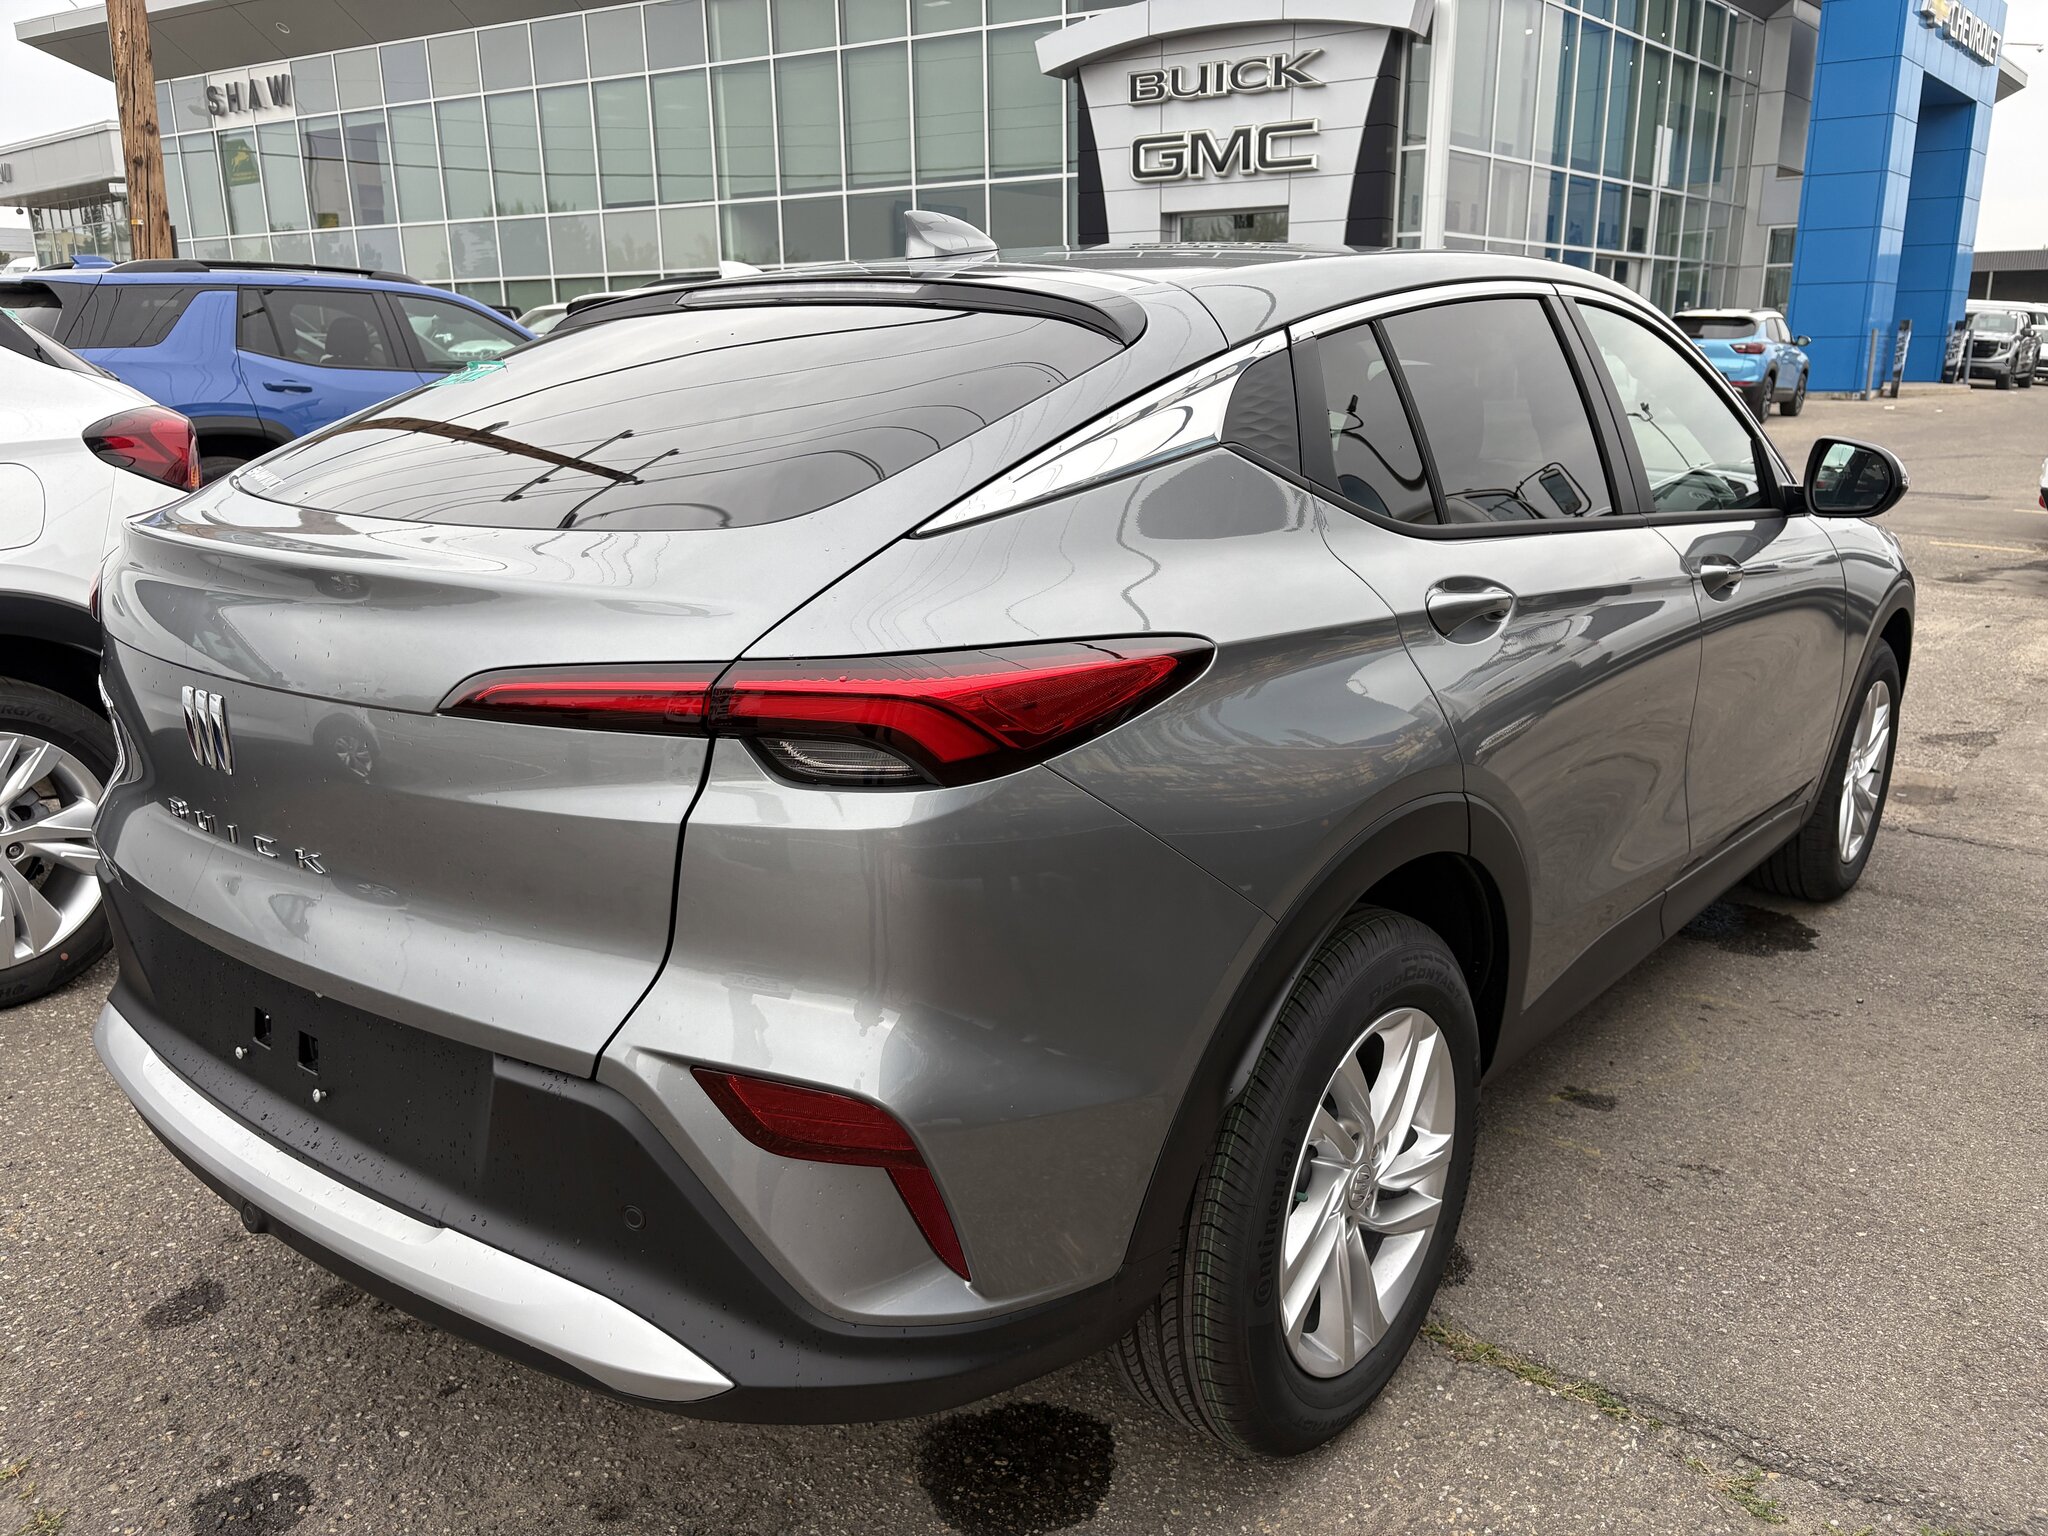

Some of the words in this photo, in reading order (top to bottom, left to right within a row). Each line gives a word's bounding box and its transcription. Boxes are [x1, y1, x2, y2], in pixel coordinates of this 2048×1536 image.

[1949, 1, 2001, 66] CHEVROLET
[206, 73, 291, 116] SHAW
[1127, 48, 1326, 106] BUICK
[1129, 118, 1320, 183] GMC
[0, 704, 39, 717] RGY
[168, 796, 326, 875] BUICK
[1252, 1136, 1297, 1309] Continental
